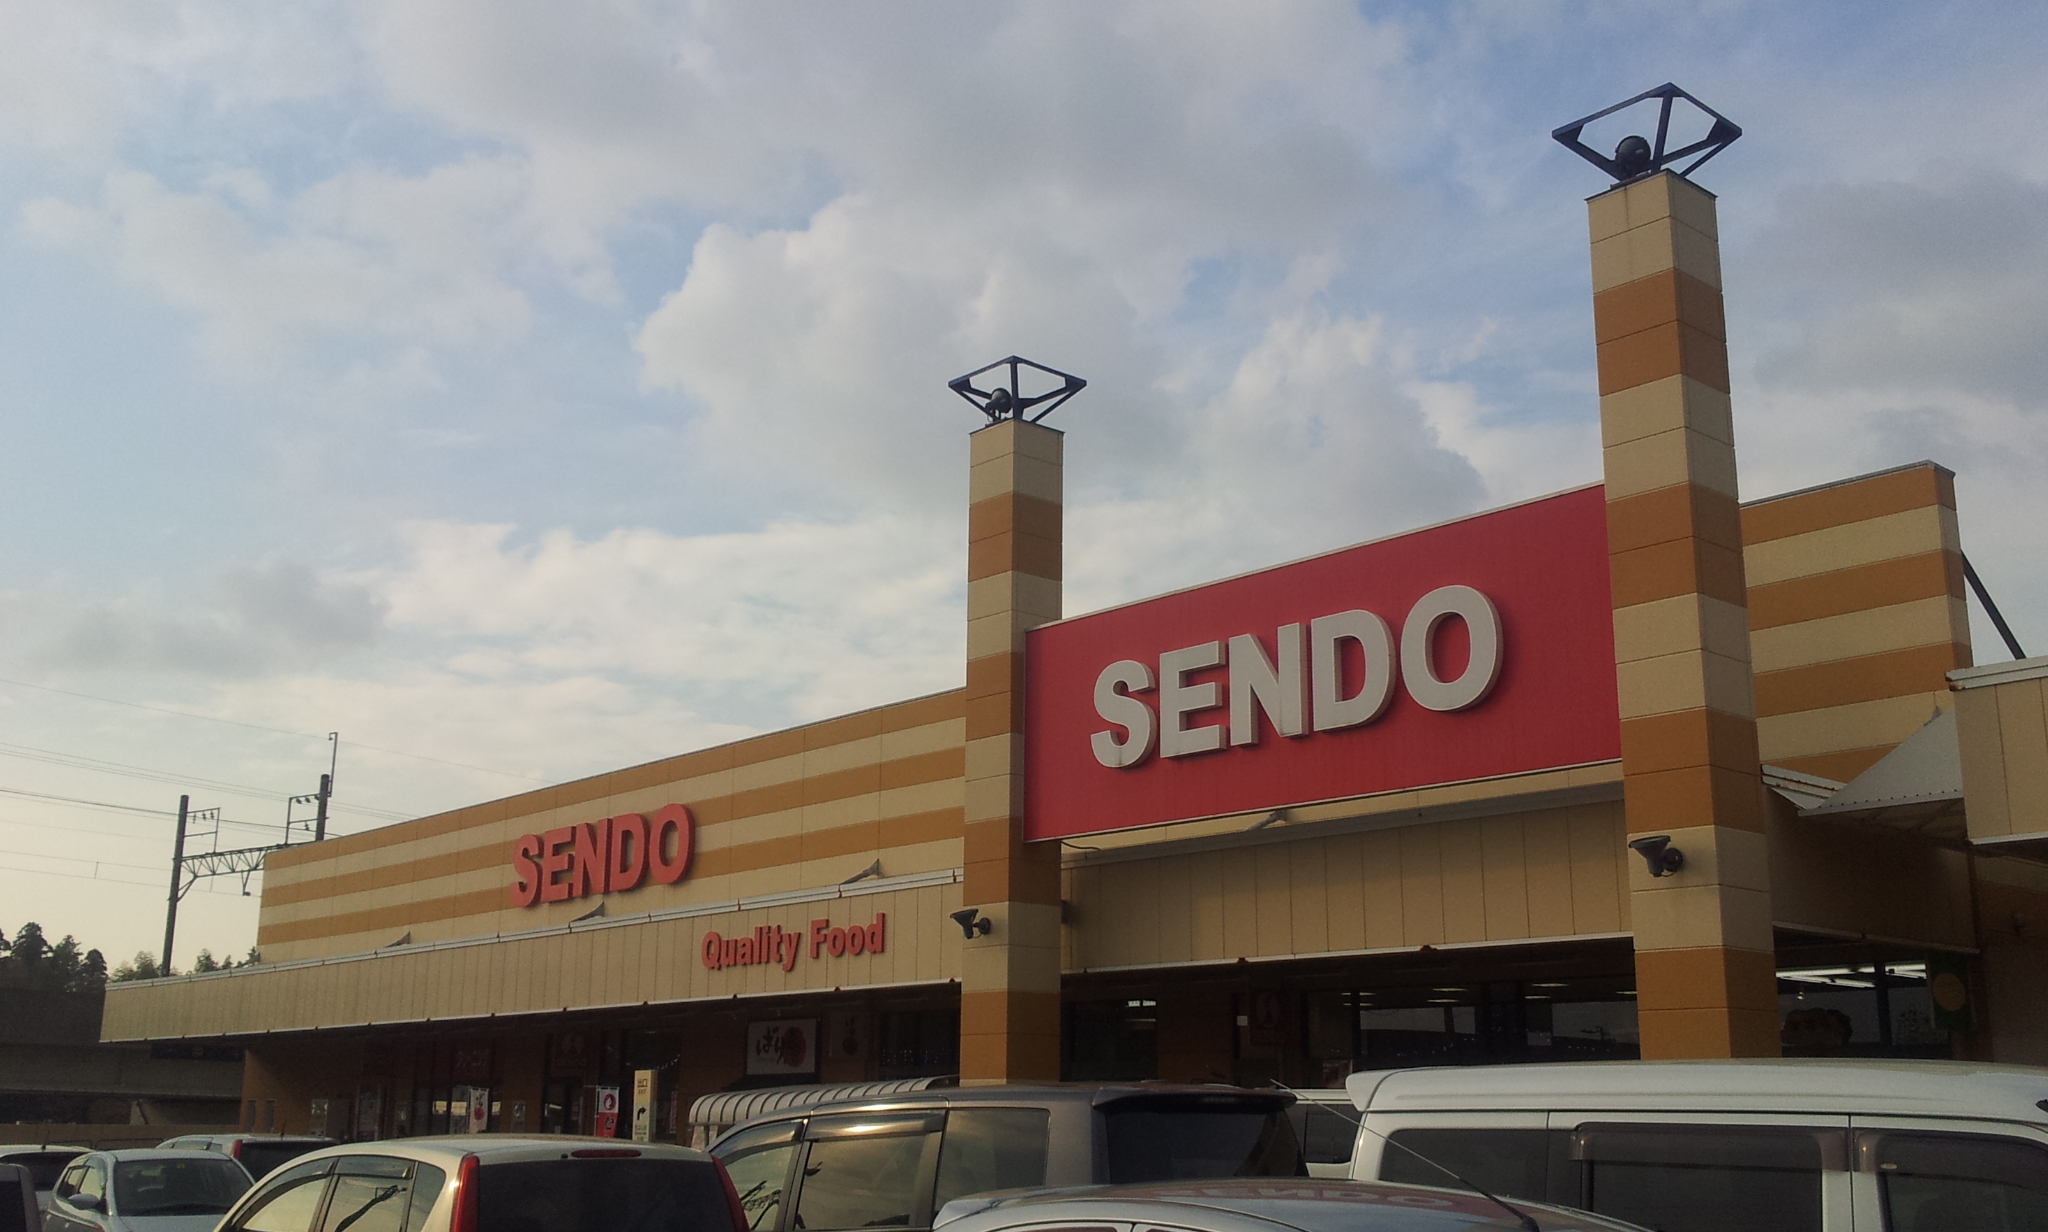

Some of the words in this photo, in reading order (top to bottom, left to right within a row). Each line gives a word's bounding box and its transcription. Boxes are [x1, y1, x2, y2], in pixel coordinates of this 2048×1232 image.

[1090, 584, 1503, 769] SENDO
[510, 803, 695, 909] SENDO
[701, 924, 801, 972] Quality
[810, 912, 885, 959] Food
